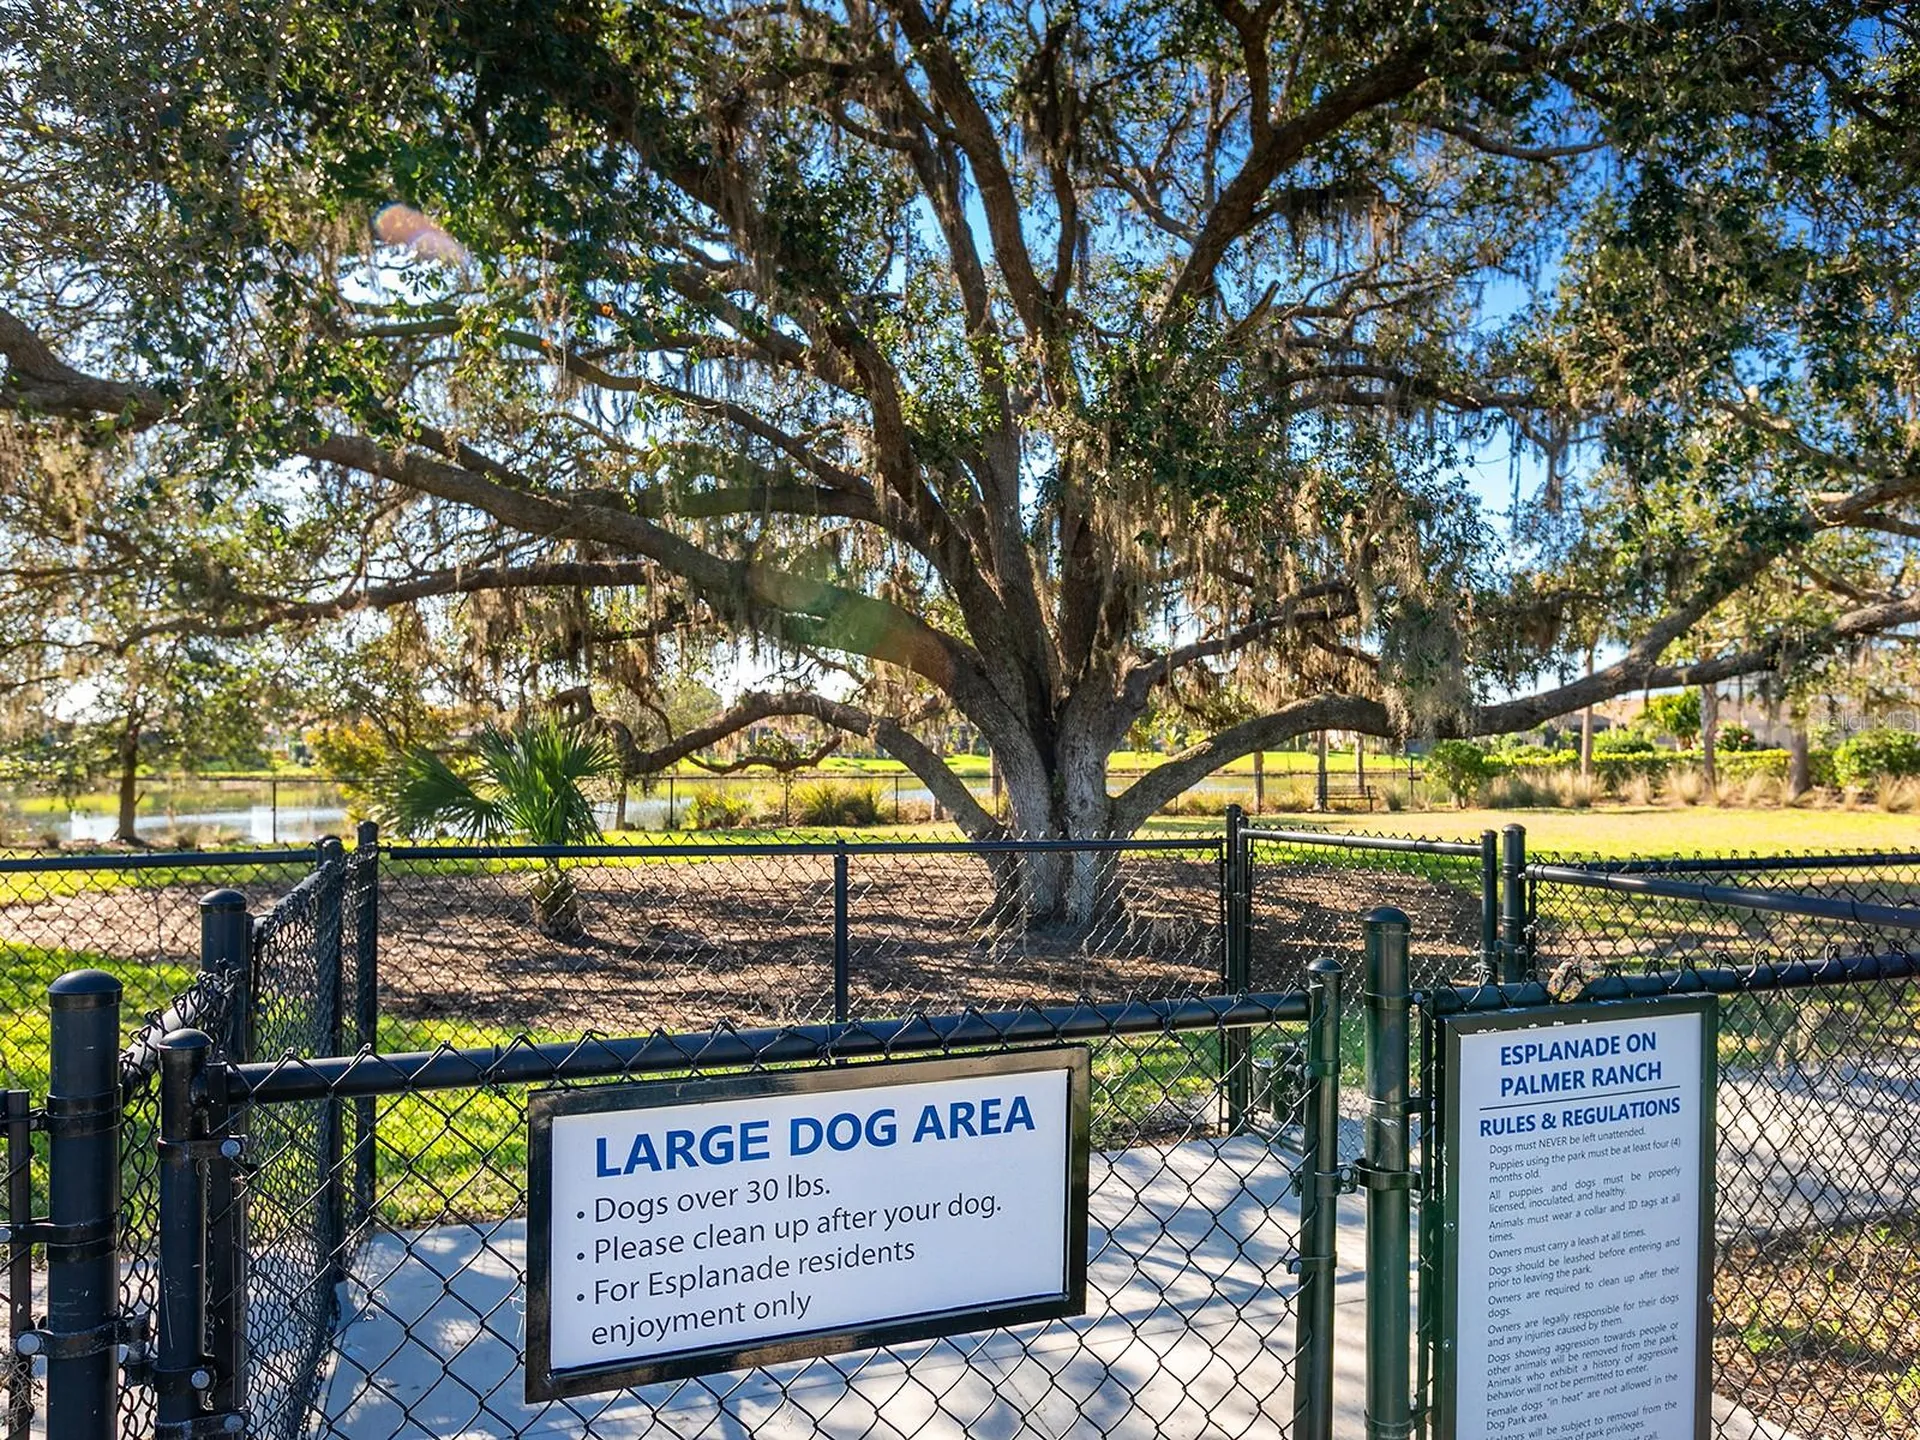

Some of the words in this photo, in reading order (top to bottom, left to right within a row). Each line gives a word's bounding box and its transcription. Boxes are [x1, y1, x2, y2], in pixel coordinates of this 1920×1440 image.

[1500, 1036, 1620, 1066] ESPLANADE
[1626, 1032, 1656, 1051] ON
[1501, 1070, 1585, 1097] PALMER
[1592, 1062, 1662, 1086] RANCH
[1480, 1113, 1536, 1137] RULES
[1542, 1112, 1556, 1129] &
[1562, 1098, 1680, 1127] REGULATIONS
[596, 1120, 770, 1177] LARGE
[790, 1109, 897, 1156] DOG
[912, 1096, 1035, 1143] AREA
[1489, 1145, 1512, 1155] Dogs
[1514, 1140, 1536, 1151] must
[1538, 1136, 1567, 1148] NEVER
[1569, 1135, 1580, 1144] be
[1582, 1133, 1596, 1142] left
[1489, 1160, 1524, 1172] Puppies
[1526, 1157, 1549, 1166] using
[1551, 1153, 1565, 1162] the
[1567, 1150, 1585, 1163] park
[1587, 1147, 1608, 1157] must
[1610, 1146, 1620, 1154] be
[1622, 1144, 1630, 1153] at
[1632, 1142, 1651, 1152] least
[1652, 1140, 1669, 1149] four
[1670, 1137, 1680, 1148] (4)
[1488, 1191, 1500, 1200] All
[1508, 1187, 1543, 1200] puppies
[1551, 1181, 1567, 1192] and
[1575, 1179, 1595, 1189] dogs
[1603, 1174, 1623, 1184] must
[1630, 1172, 1640, 1181] be
[1648, 1166, 1680, 1181] properly
[1489, 1172, 1522, 1183] months
[1577, 1190, 1593, 1201] and
[594, 1193, 668, 1228] Dogs
[677, 1187, 738, 1212] over
[746, 1179, 778, 1204] 30
[787, 1174, 831, 1198] lbs.
[1488, 1217, 1524, 1229] Animals
[1527, 1213, 1548, 1224] must
[1552, 1211, 1573, 1220] wear
[1584, 1205, 1606, 1215] collar
[1610, 1201, 1625, 1212] and
[1628, 1200, 1637, 1209] ID
[1640, 1199, 1657, 1209] tags
[1660, 1196, 1669, 1204] at
[1671, 1193, 1680, 1203] all
[594, 1233, 685, 1264] Please
[693, 1221, 765, 1251] clean
[775, 1218, 809, 1248] up
[817, 1207, 877, 1234] after
[884, 1201, 941, 1232] your
[947, 1192, 1001, 1226] dog.
[1488, 1248, 1522, 1259] Owners
[1524, 1243, 1545, 1253] must
[1547, 1241, 1567, 1250] carry
[1577, 1234, 1599, 1245] leash
[1601, 1233, 1609, 1242] at
[1610, 1231, 1620, 1240] all
[594, 1276, 640, 1305] For
[648, 1256, 790, 1303] Esplanade
[798, 1239, 915, 1275] residents
[1488, 1266, 1511, 1277] Dogs
[1515, 1259, 1544, 1272] should
[1548, 1257, 1560, 1266] be
[1563, 1251, 1595, 1264] leashed
[1598, 1248, 1625, 1258] before
[1628, 1242, 1661, 1253] entering
[1665, 1237, 1680, 1247] and
[1488, 1279, 1509, 1291] prior
[1511, 1277, 1521, 1285] to
[1523, 1272, 1553, 1283] leaving
[1556, 1268, 1570, 1278] the
[1488, 1293, 1521, 1305] Owners
[1525, 1290, 1539, 1299] are
[1544, 1282, 1580, 1296] required
[1584, 1281, 1593, 1289] to
[1598, 1277, 1619, 1287] clean
[1623, 1275, 1634, 1284] up
[1638, 1270, 1656, 1280] after
[1661, 1266, 1679, 1276] their
[592, 1301, 746, 1348] enjoyment
[753, 1291, 811, 1325] only
[1487, 1322, 1521, 1334] Owners
[1524, 1319, 1538, 1328] are
[1542, 1313, 1569, 1326] legally
[1573, 1304, 1619, 1319] responsible
[1623, 1302, 1634, 1311] for
[1638, 1298, 1656, 1308] their
[1659, 1295, 1679, 1305] dogs
[1487, 1336, 1504, 1347] and
[1506, 1335, 1522, 1344] any
[1524, 1329, 1555, 1342] injuries
[1557, 1321, 1587, 1335] caused
[1588, 1320, 1599, 1331] by
[1487, 1353, 1510, 1364] Dogs
[1514, 1346, 1550, 1359] showing
[1554, 1337, 1599, 1353] aggression
[1603, 1329, 1636, 1342] towards
[1639, 1323, 1667, 1338] people
[1487, 1365, 1510, 1376] other
[1514, 1358, 1547, 1371] animals
[1550, 1354, 1564, 1364] will
[1568, 1352, 1578, 1361] be
[1582, 1344, 1618, 1358] removed
[1621, 1341, 1640, 1351] from
[1643, 1337, 1656, 1347] the
[1487, 1375, 1521, 1388] Animals
[1526, 1371, 1545, 1381] who
[1549, 1364, 1578, 1377] exhibit
[1592, 1358, 1620, 1369] history
[1624, 1353, 1633, 1363] of
[1637, 1347, 1678, 1362] aggressive
[1486, 1405, 1518, 1418] Female
[1521, 1401, 1542, 1411] dogs
[1547, 1397, 1558, 1405] "in
[1561, 1390, 1583, 1403] heat"
[1586, 1389, 1600, 1398] are
[1603, 1384, 1617, 1394] not
[1620, 1377, 1651, 1391] allowed
[1654, 1376, 1662, 1384] in
[1665, 1372, 1678, 1382] the
[1487, 1388, 1525, 1401] behavior
[1526, 1383, 1541, 1394] will
[1543, 1380, 1557, 1390] not
[1560, 1378, 1571, 1387] be
[1573, 1369, 1613, 1387] permitted
[1615, 1369, 1624, 1377] to
[1486, 1421, 1504, 1430] Dog
[1507, 1415, 1525, 1426] Park
[1528, 1425, 1542, 1436] will
[1546, 1423, 1557, 1432] be
[1561, 1416, 1591, 1429] subject
[1594, 1414, 1603, 1422] to
[1606, 1405, 1638, 1420] removal
[1642, 1403, 1661, 1413] from
[1664, 1399, 1677, 1408] the
[1586, 1427, 1604, 1440] park
